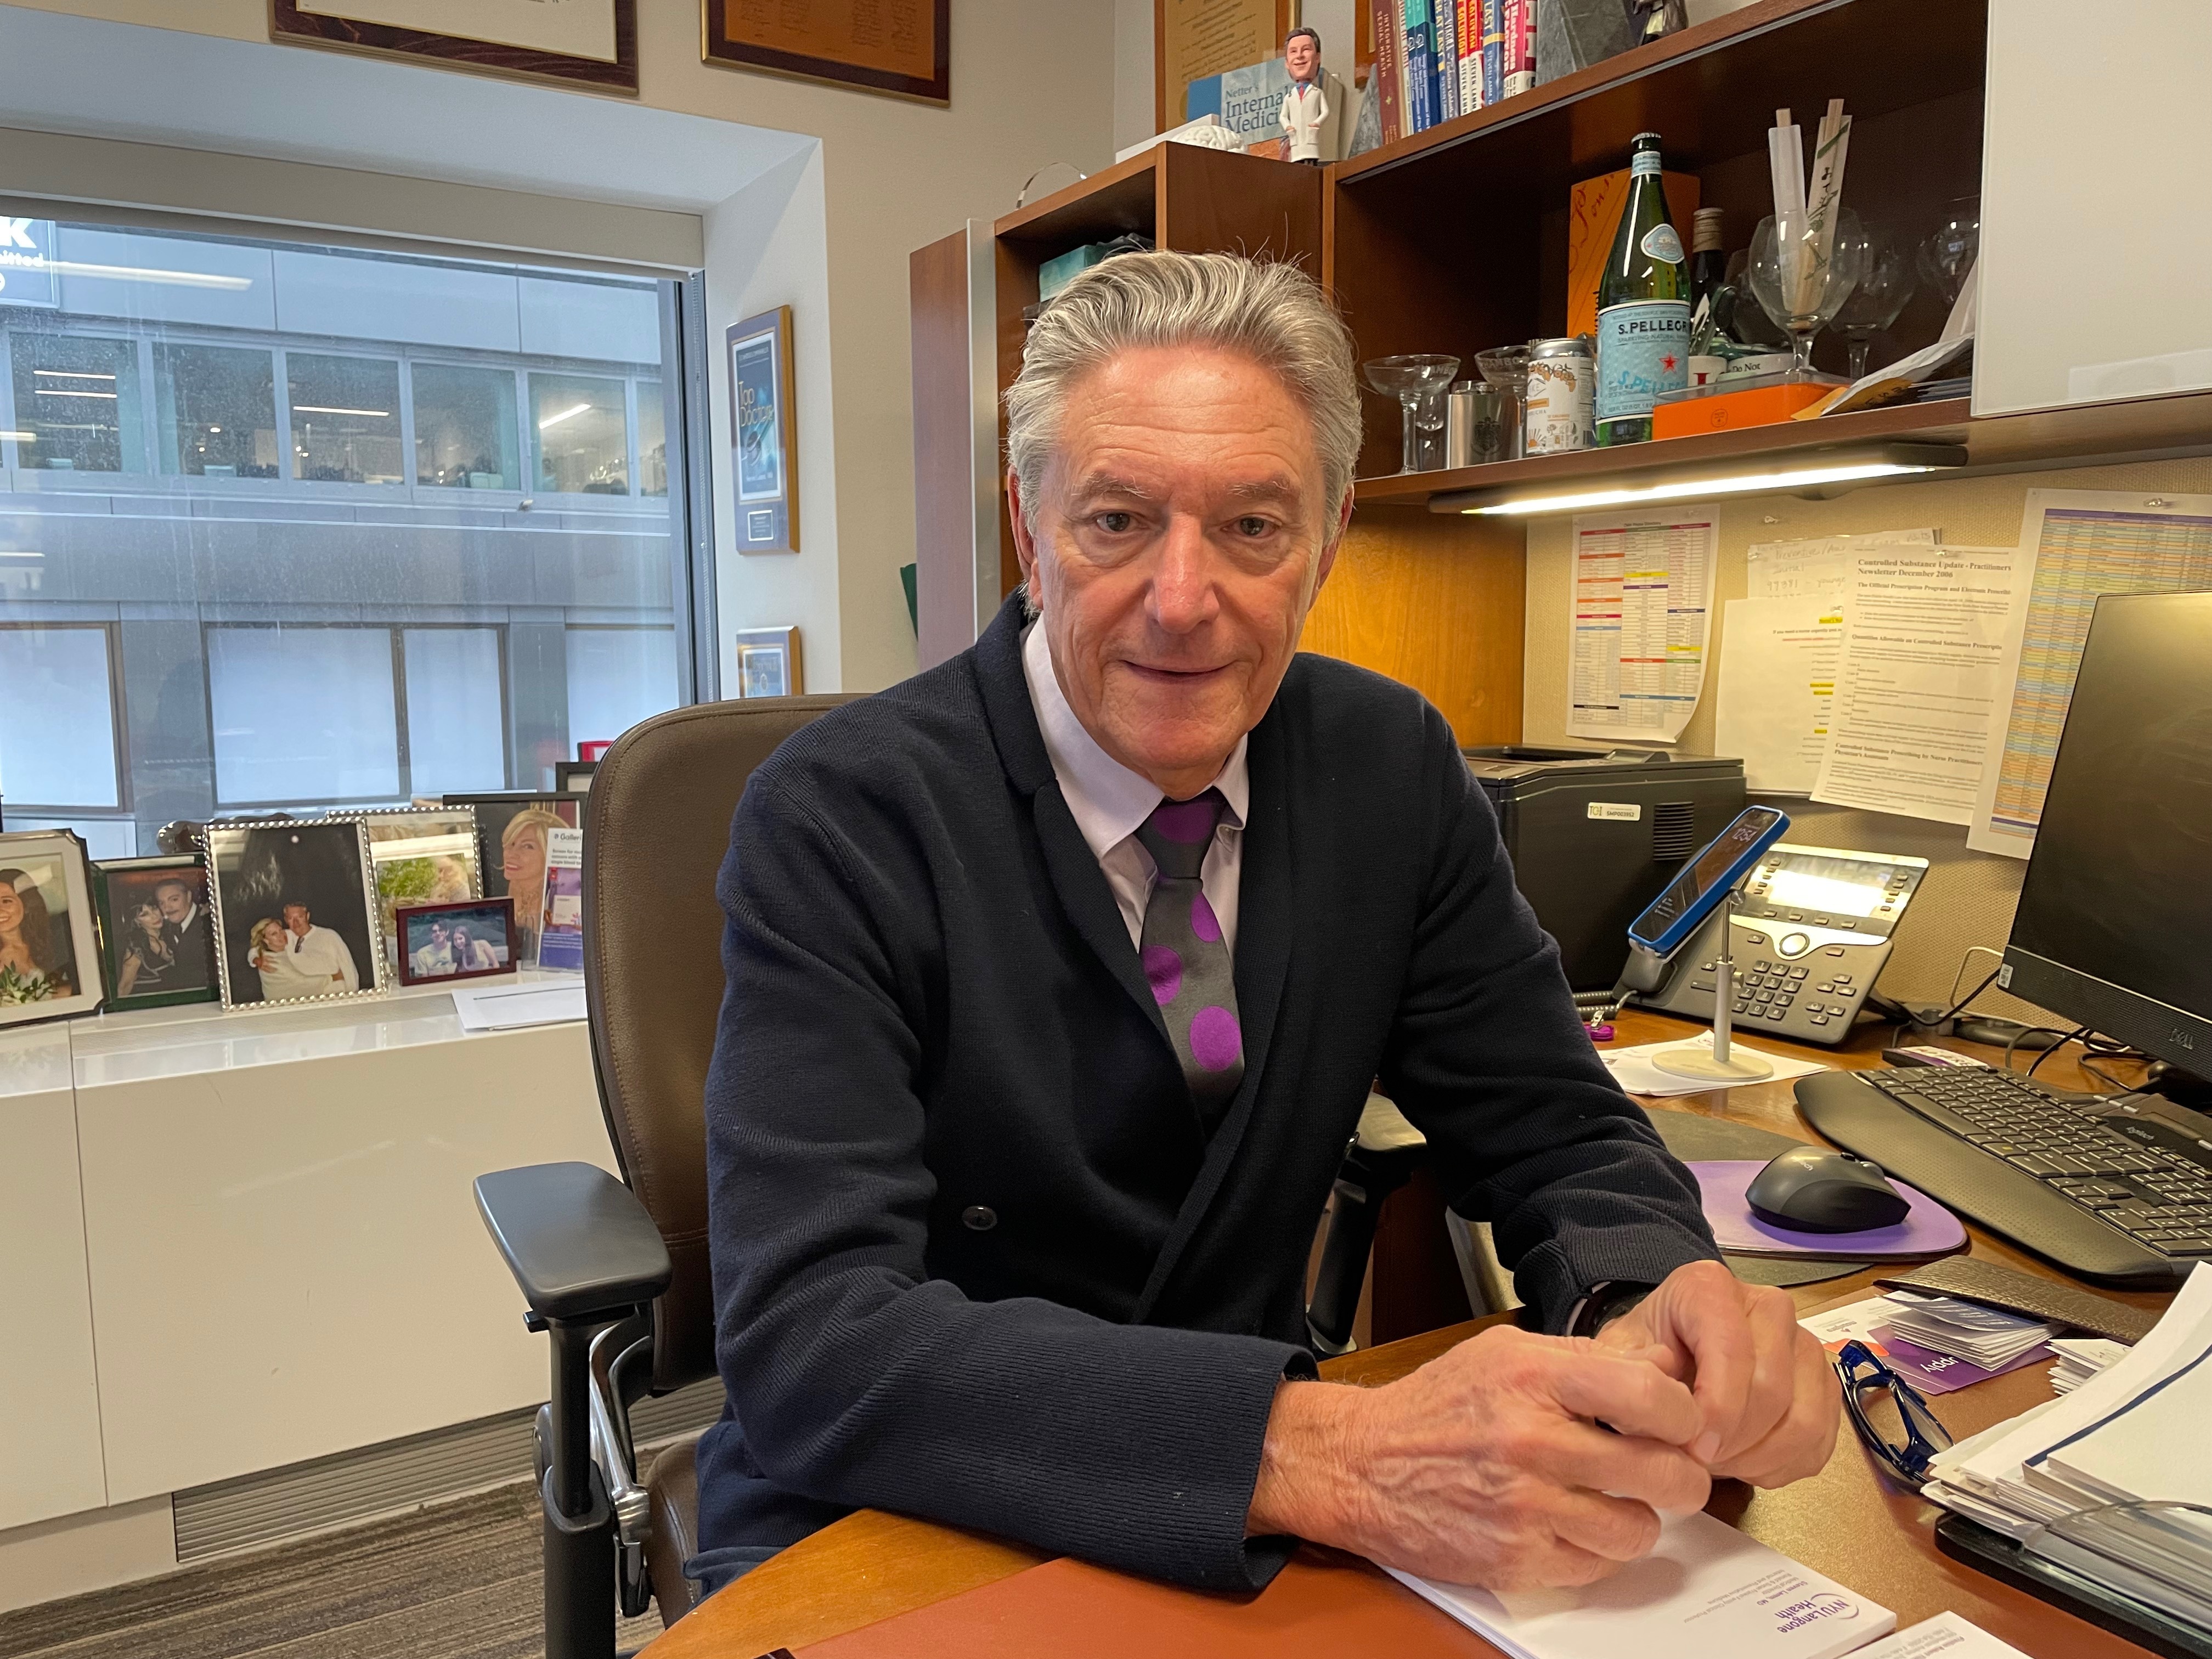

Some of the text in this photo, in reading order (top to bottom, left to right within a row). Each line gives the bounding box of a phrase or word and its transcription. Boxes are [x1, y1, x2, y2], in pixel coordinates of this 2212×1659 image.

[1444, 18, 1454, 51] VIAGRA
[1225, 85, 1260, 99] Netter's
[1225, 107, 1280, 133] Medici
[738, 381, 755, 406] Top
[1786, 1580, 1808, 1592] Steven
[1774, 1599, 1817, 1620] Health
